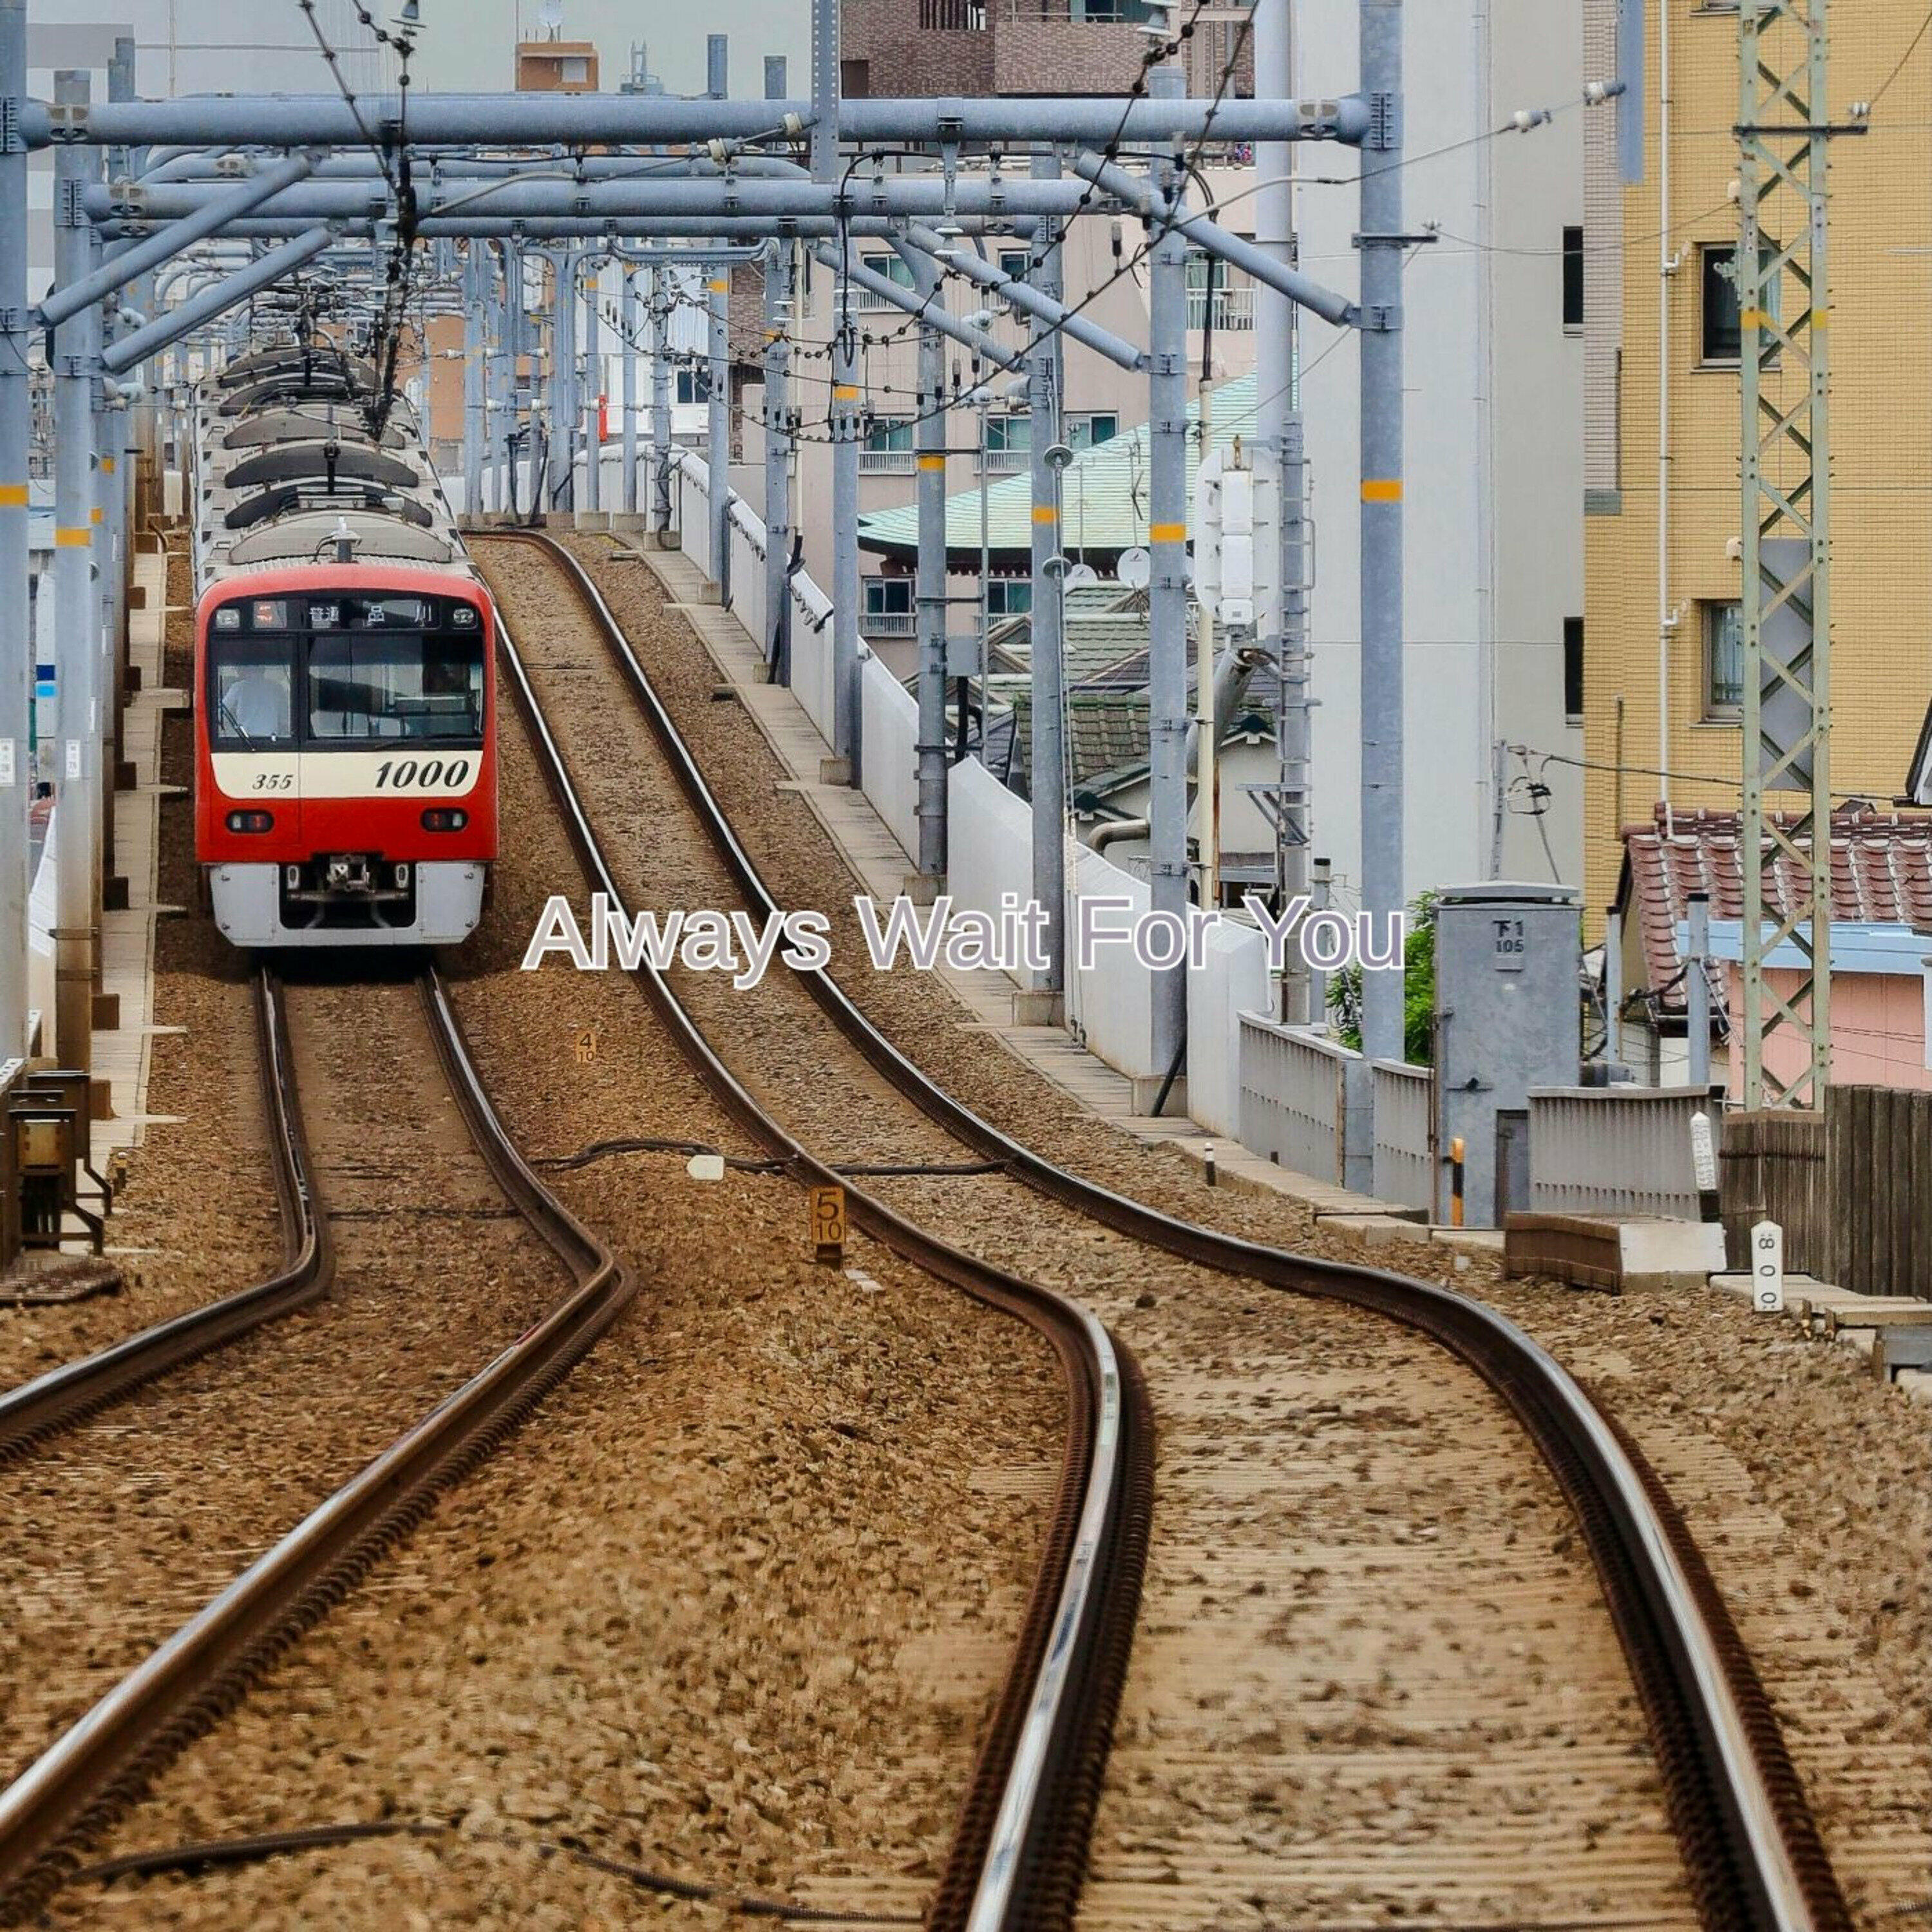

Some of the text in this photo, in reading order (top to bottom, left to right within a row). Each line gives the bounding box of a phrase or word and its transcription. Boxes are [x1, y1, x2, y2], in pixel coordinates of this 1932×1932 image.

[252, 775, 293, 790] 355
[375, 760, 469, 789] 1000
[1496, 940, 1524, 952] 105
[580, 1033, 592, 1049] 4
[580, 1050, 594, 1064] 10
[817, 1191, 838, 1220] 5
[818, 1222, 842, 1240] 10
[1759, 1237, 1777, 1303] 800
